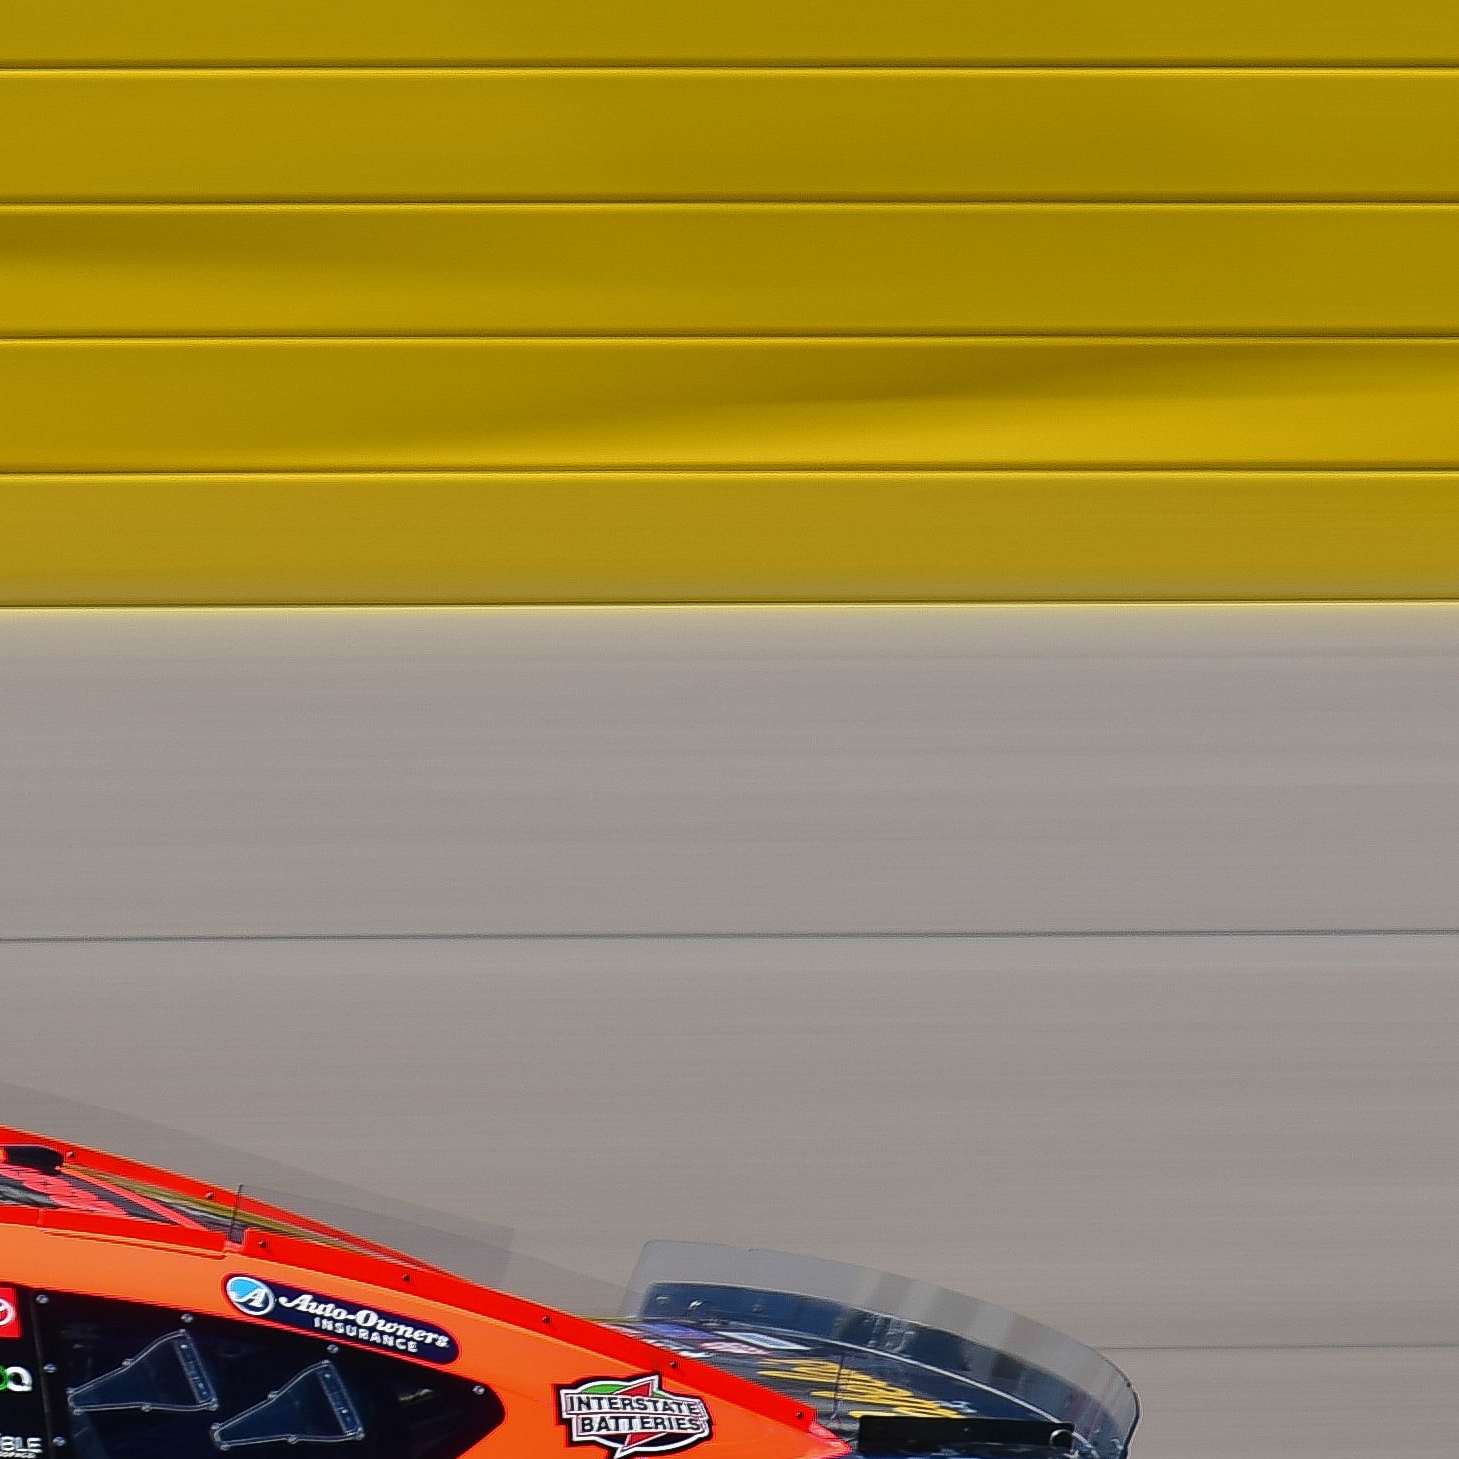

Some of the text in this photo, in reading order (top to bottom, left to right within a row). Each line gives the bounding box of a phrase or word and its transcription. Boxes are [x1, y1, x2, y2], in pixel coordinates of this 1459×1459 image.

[278, 1293, 450, 1348] Auto-Owners
[313, 1316, 419, 1353] INSURANCE
[568, 1395, 701, 1415] INTERSTATE
[581, 1415, 700, 1433] BATTERIES
